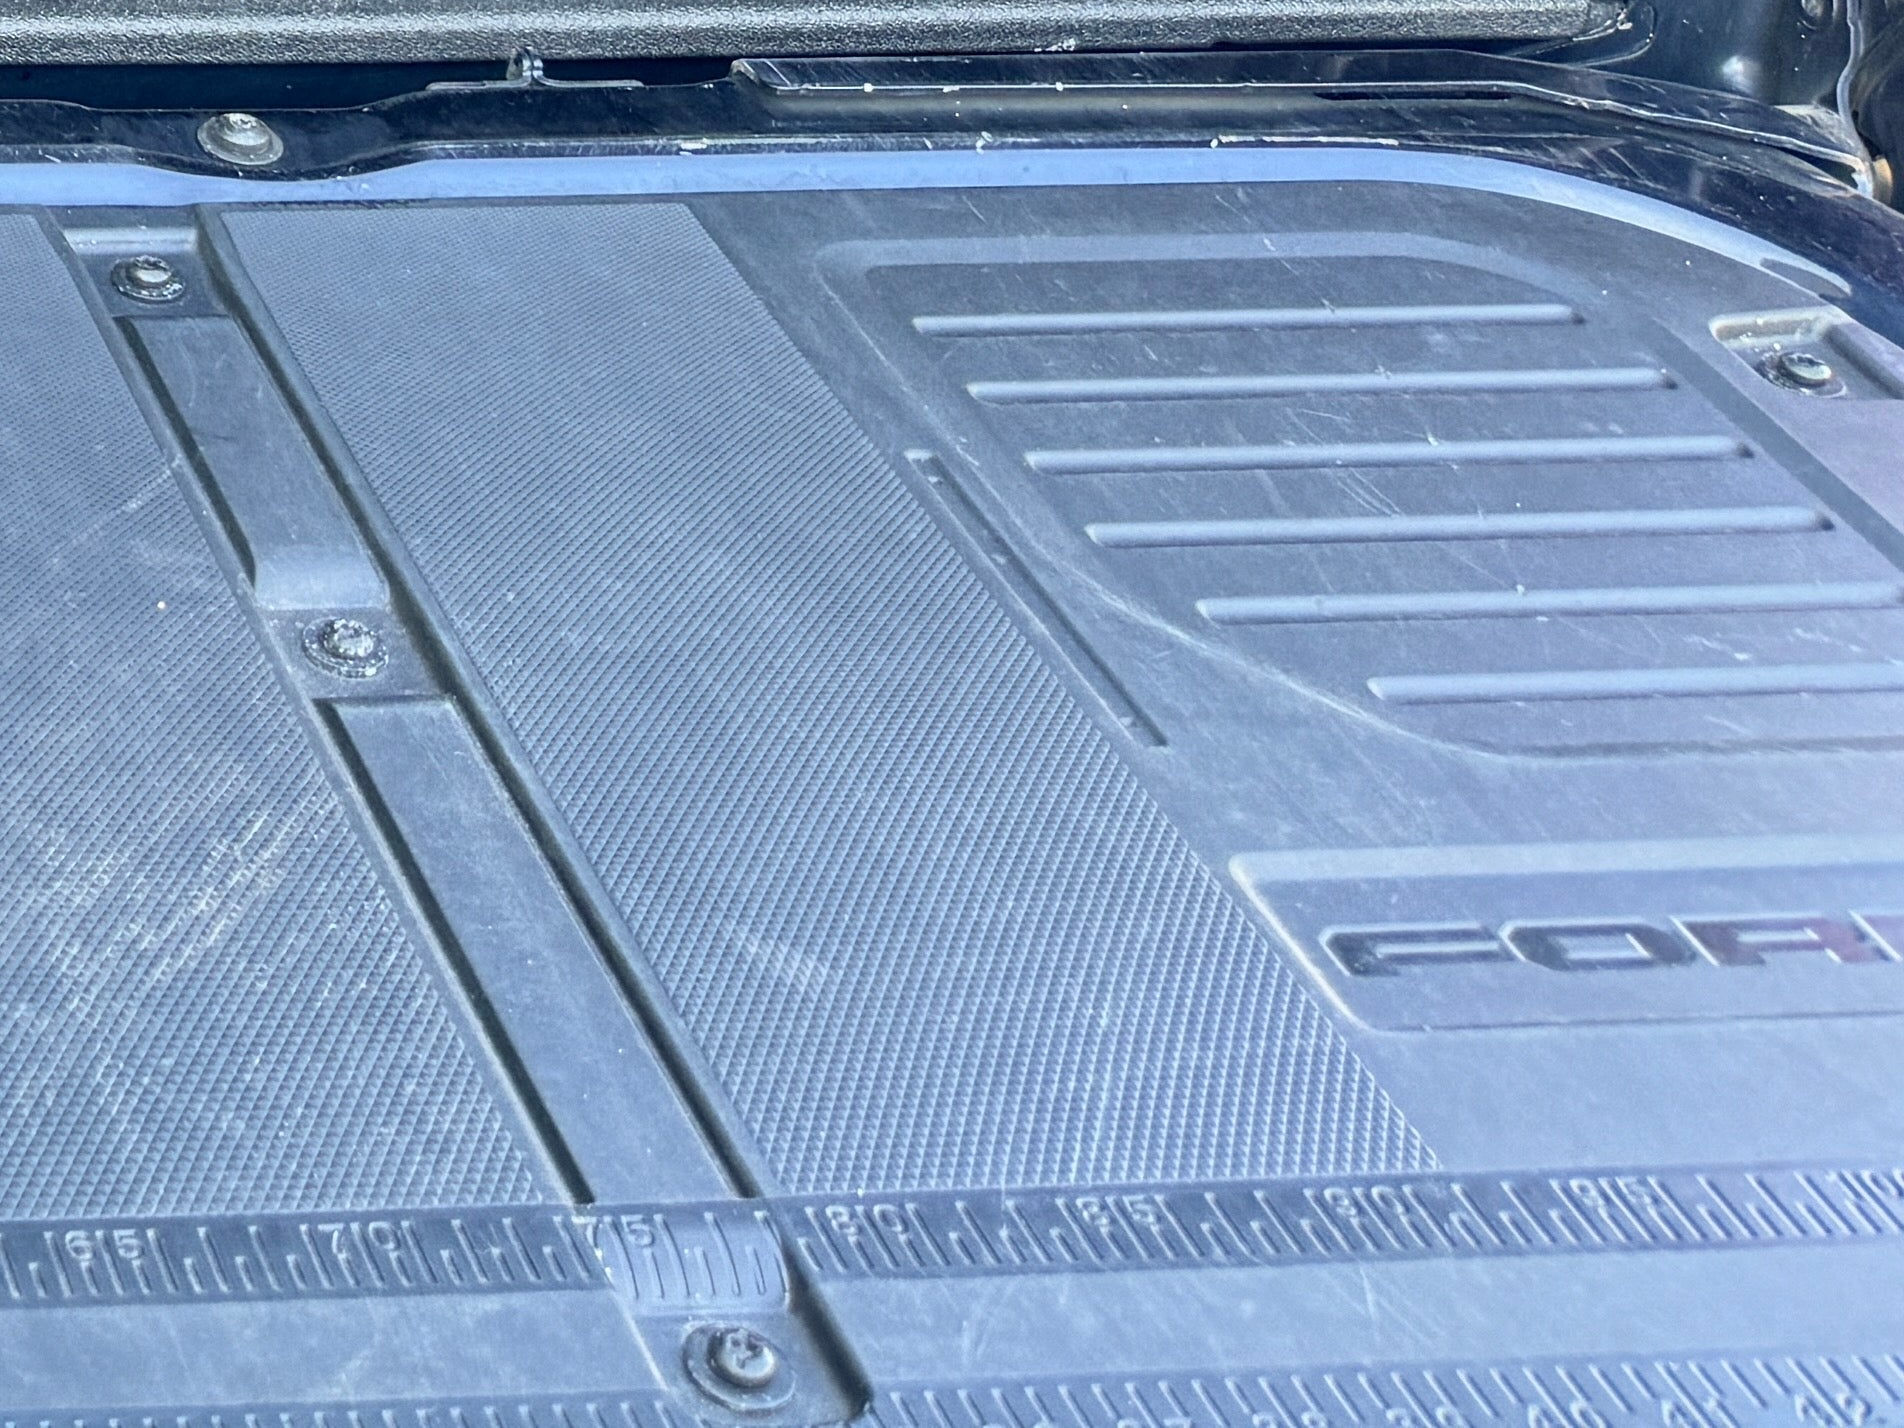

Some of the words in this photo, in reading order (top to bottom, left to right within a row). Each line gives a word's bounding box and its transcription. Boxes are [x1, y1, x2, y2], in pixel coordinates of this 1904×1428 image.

[1322, 910, 1904, 977] FOR
[64, 1227, 144, 1260] 65
[317, 1220, 399, 1255] 70
[571, 1214, 655, 1250] 75
[825, 1204, 908, 1236] 80
[1568, 1177, 1661, 1208] 95
